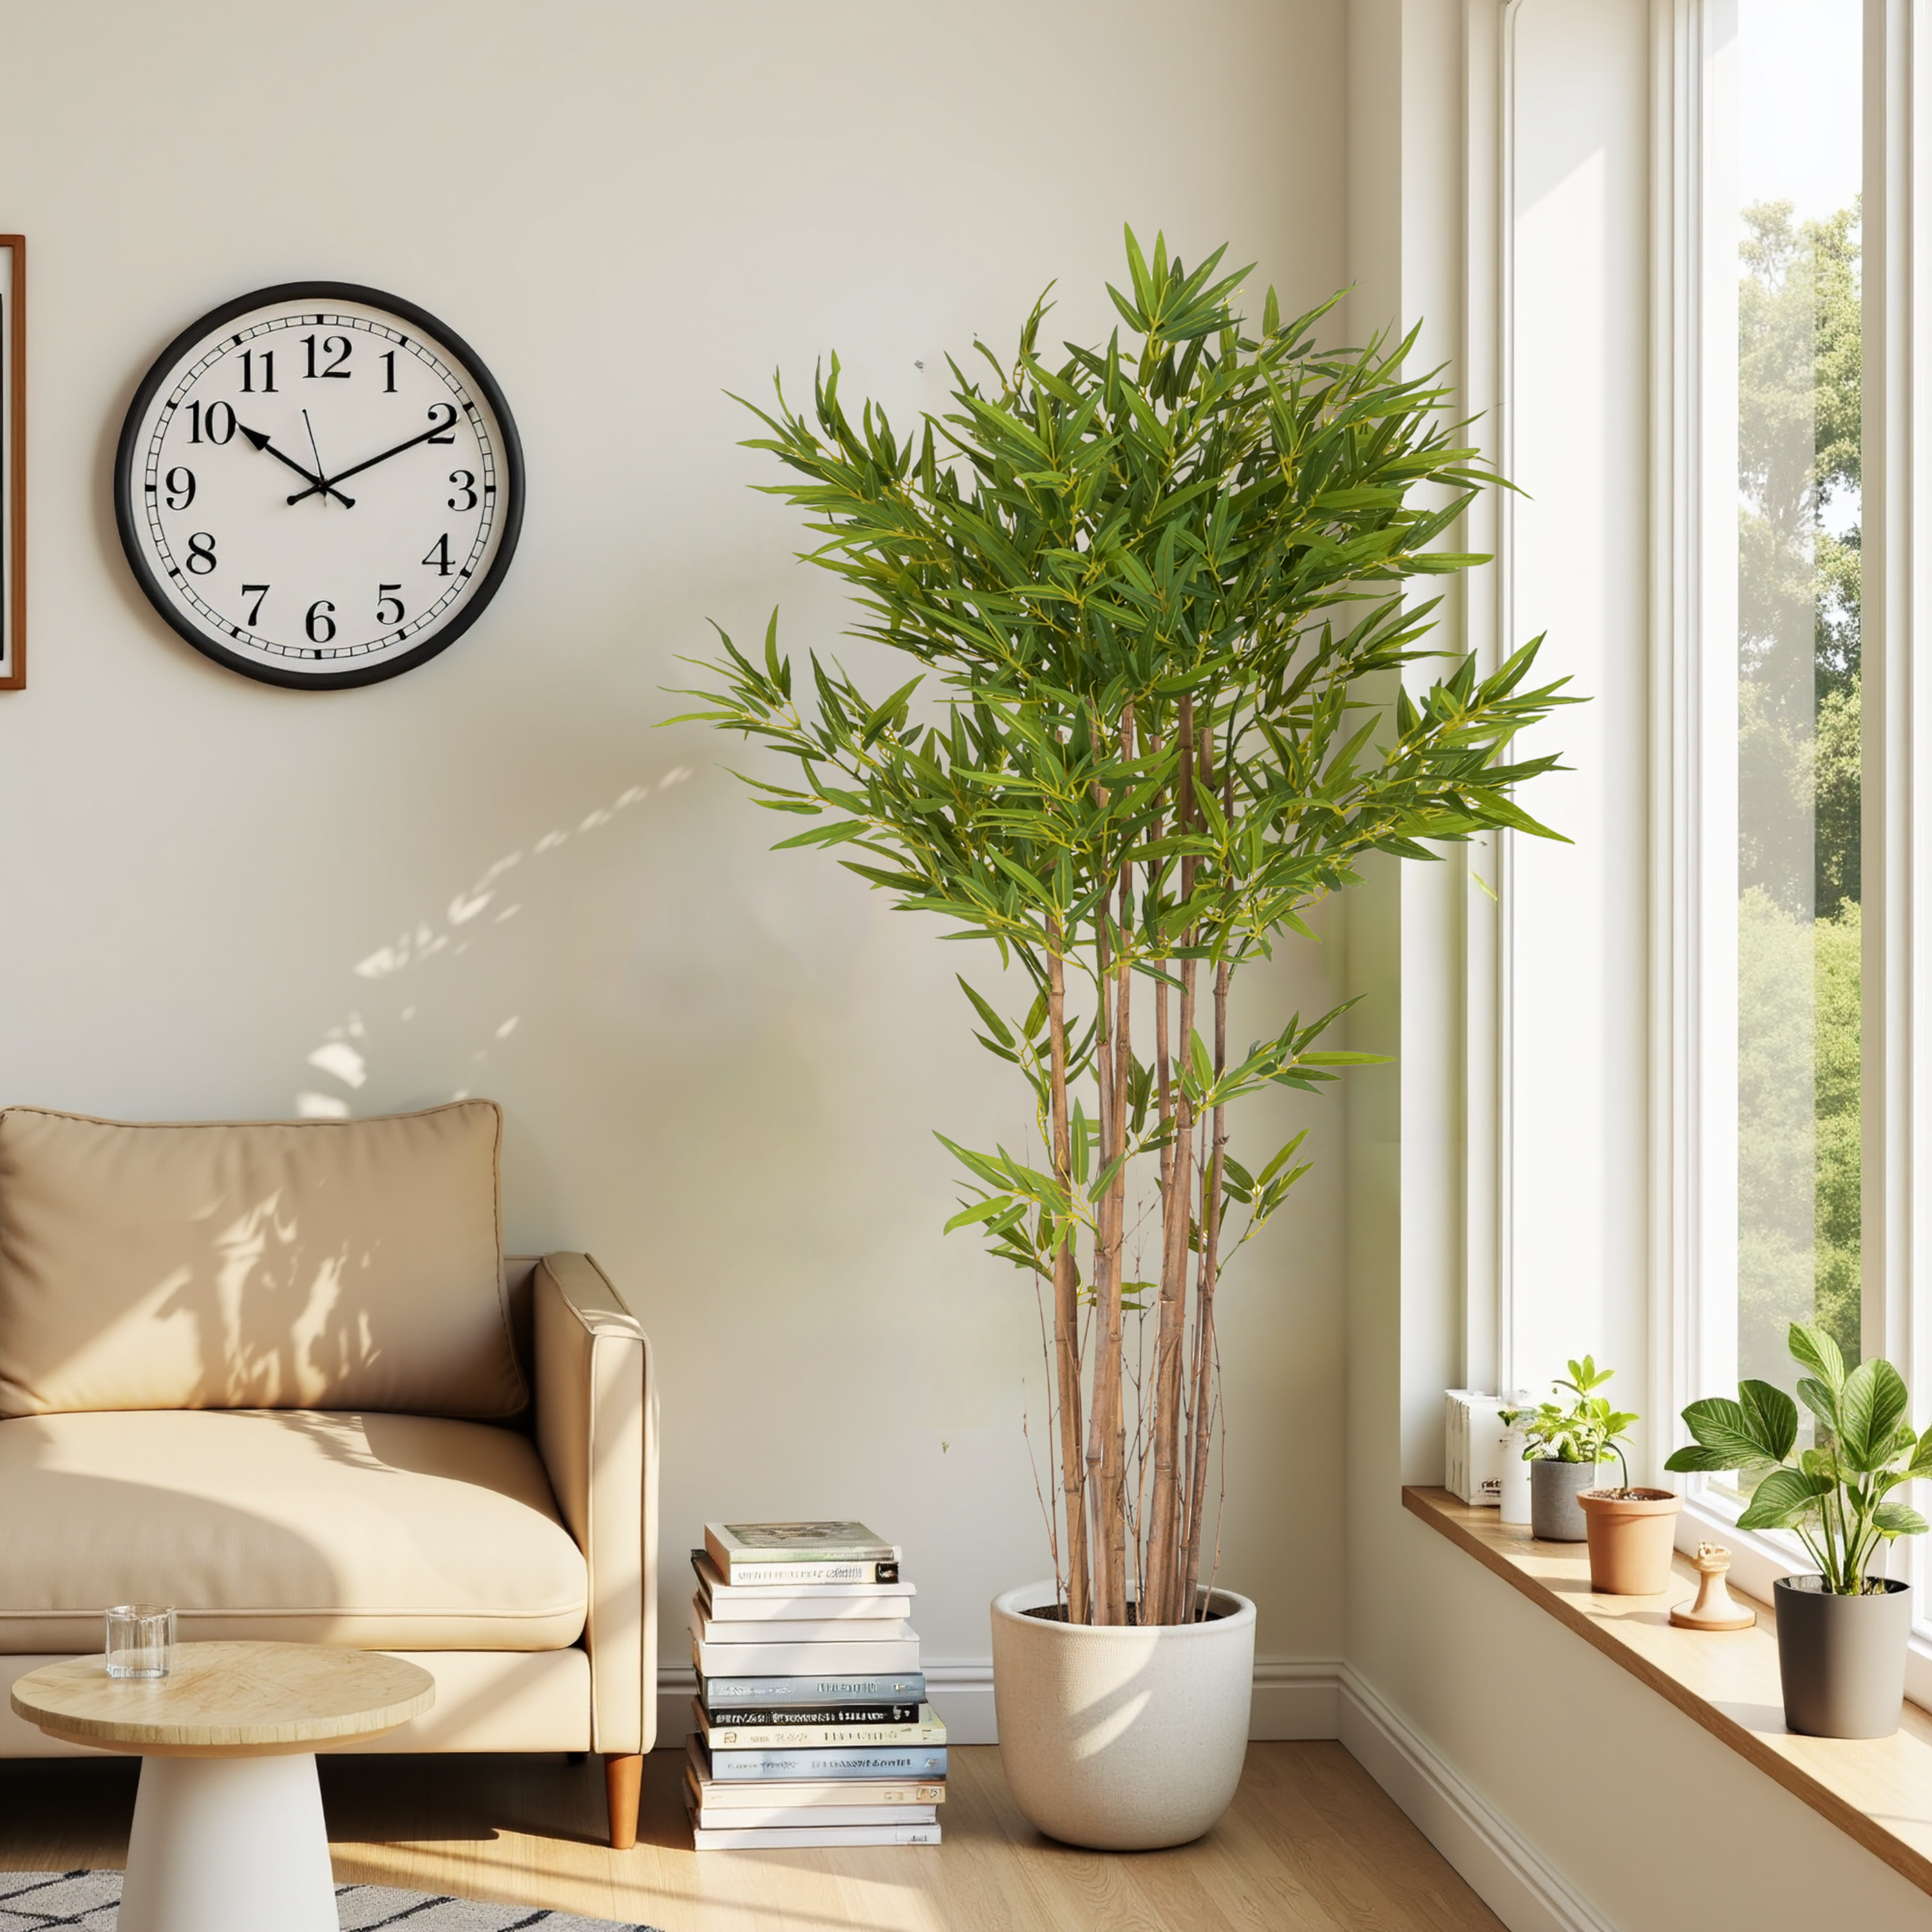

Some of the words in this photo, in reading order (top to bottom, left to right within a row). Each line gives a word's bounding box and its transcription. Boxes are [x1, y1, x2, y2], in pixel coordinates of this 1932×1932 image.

[237, 348, 279, 393] 11
[299, 334, 352, 379] 12
[379, 350, 398, 393] 1
[185, 399, 236, 445] 10
[428, 402, 457, 444] 2
[166, 466, 196, 511] 9
[448, 469, 478, 512] 3
[185, 532, 217, 575] 8
[421, 533, 456, 576] 4
[241, 583, 270, 627] 7
[305, 600, 336, 643] 6
[376, 583, 405, 625] 5
